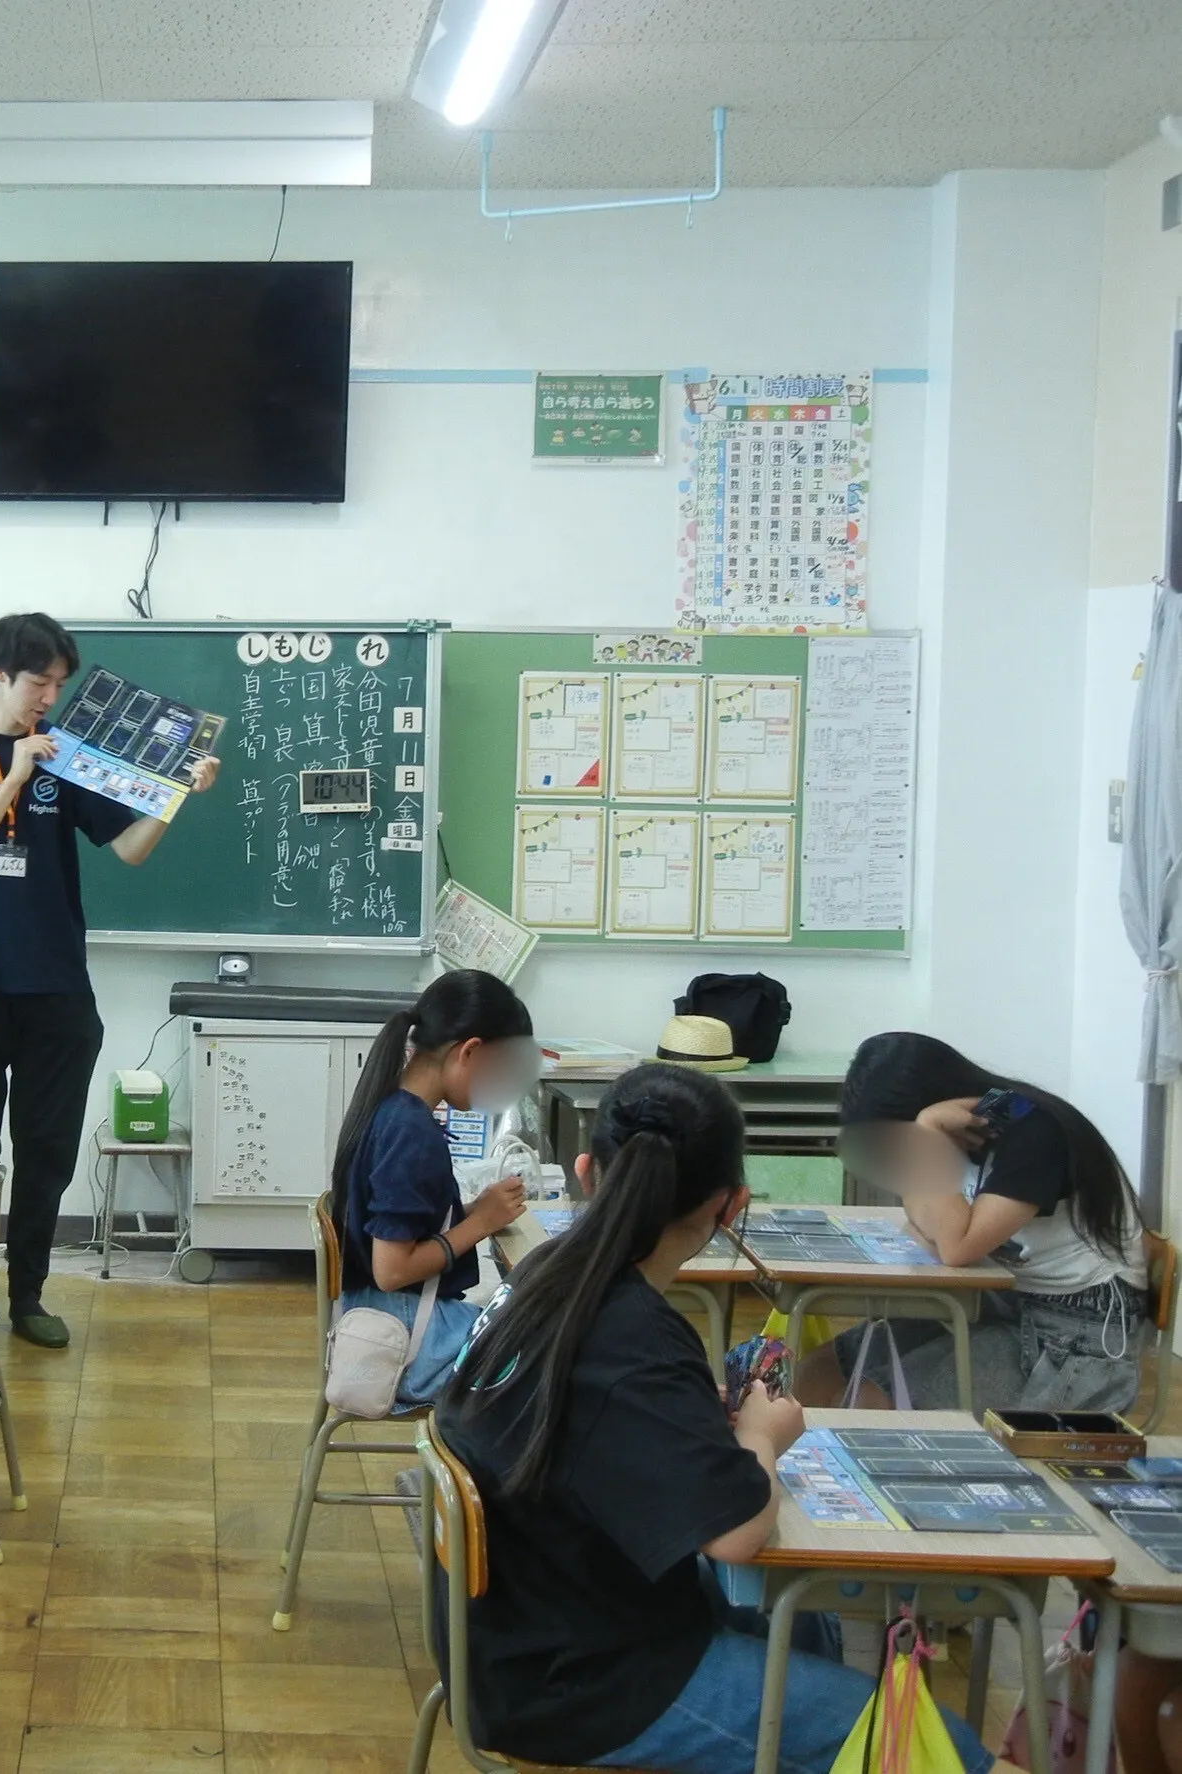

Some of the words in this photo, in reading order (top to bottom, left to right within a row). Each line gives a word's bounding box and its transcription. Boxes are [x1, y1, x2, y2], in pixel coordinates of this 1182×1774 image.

[765, 377, 844, 398] 時間割表
[732, 410, 742, 420] 月
[752, 410, 764, 420] 火
[773, 410, 784, 420] 水
[794, 410, 806, 420] 木
[815, 410, 826, 420] 金
[248, 638, 263, 658] し
[274, 635, 292, 657] も
[309, 635, 326, 657] じ
[361, 638, 385, 660] れ
[302, 671, 325, 700] 国
[238, 669, 266, 760] 自主学習
[296, 712, 330, 745] 算
